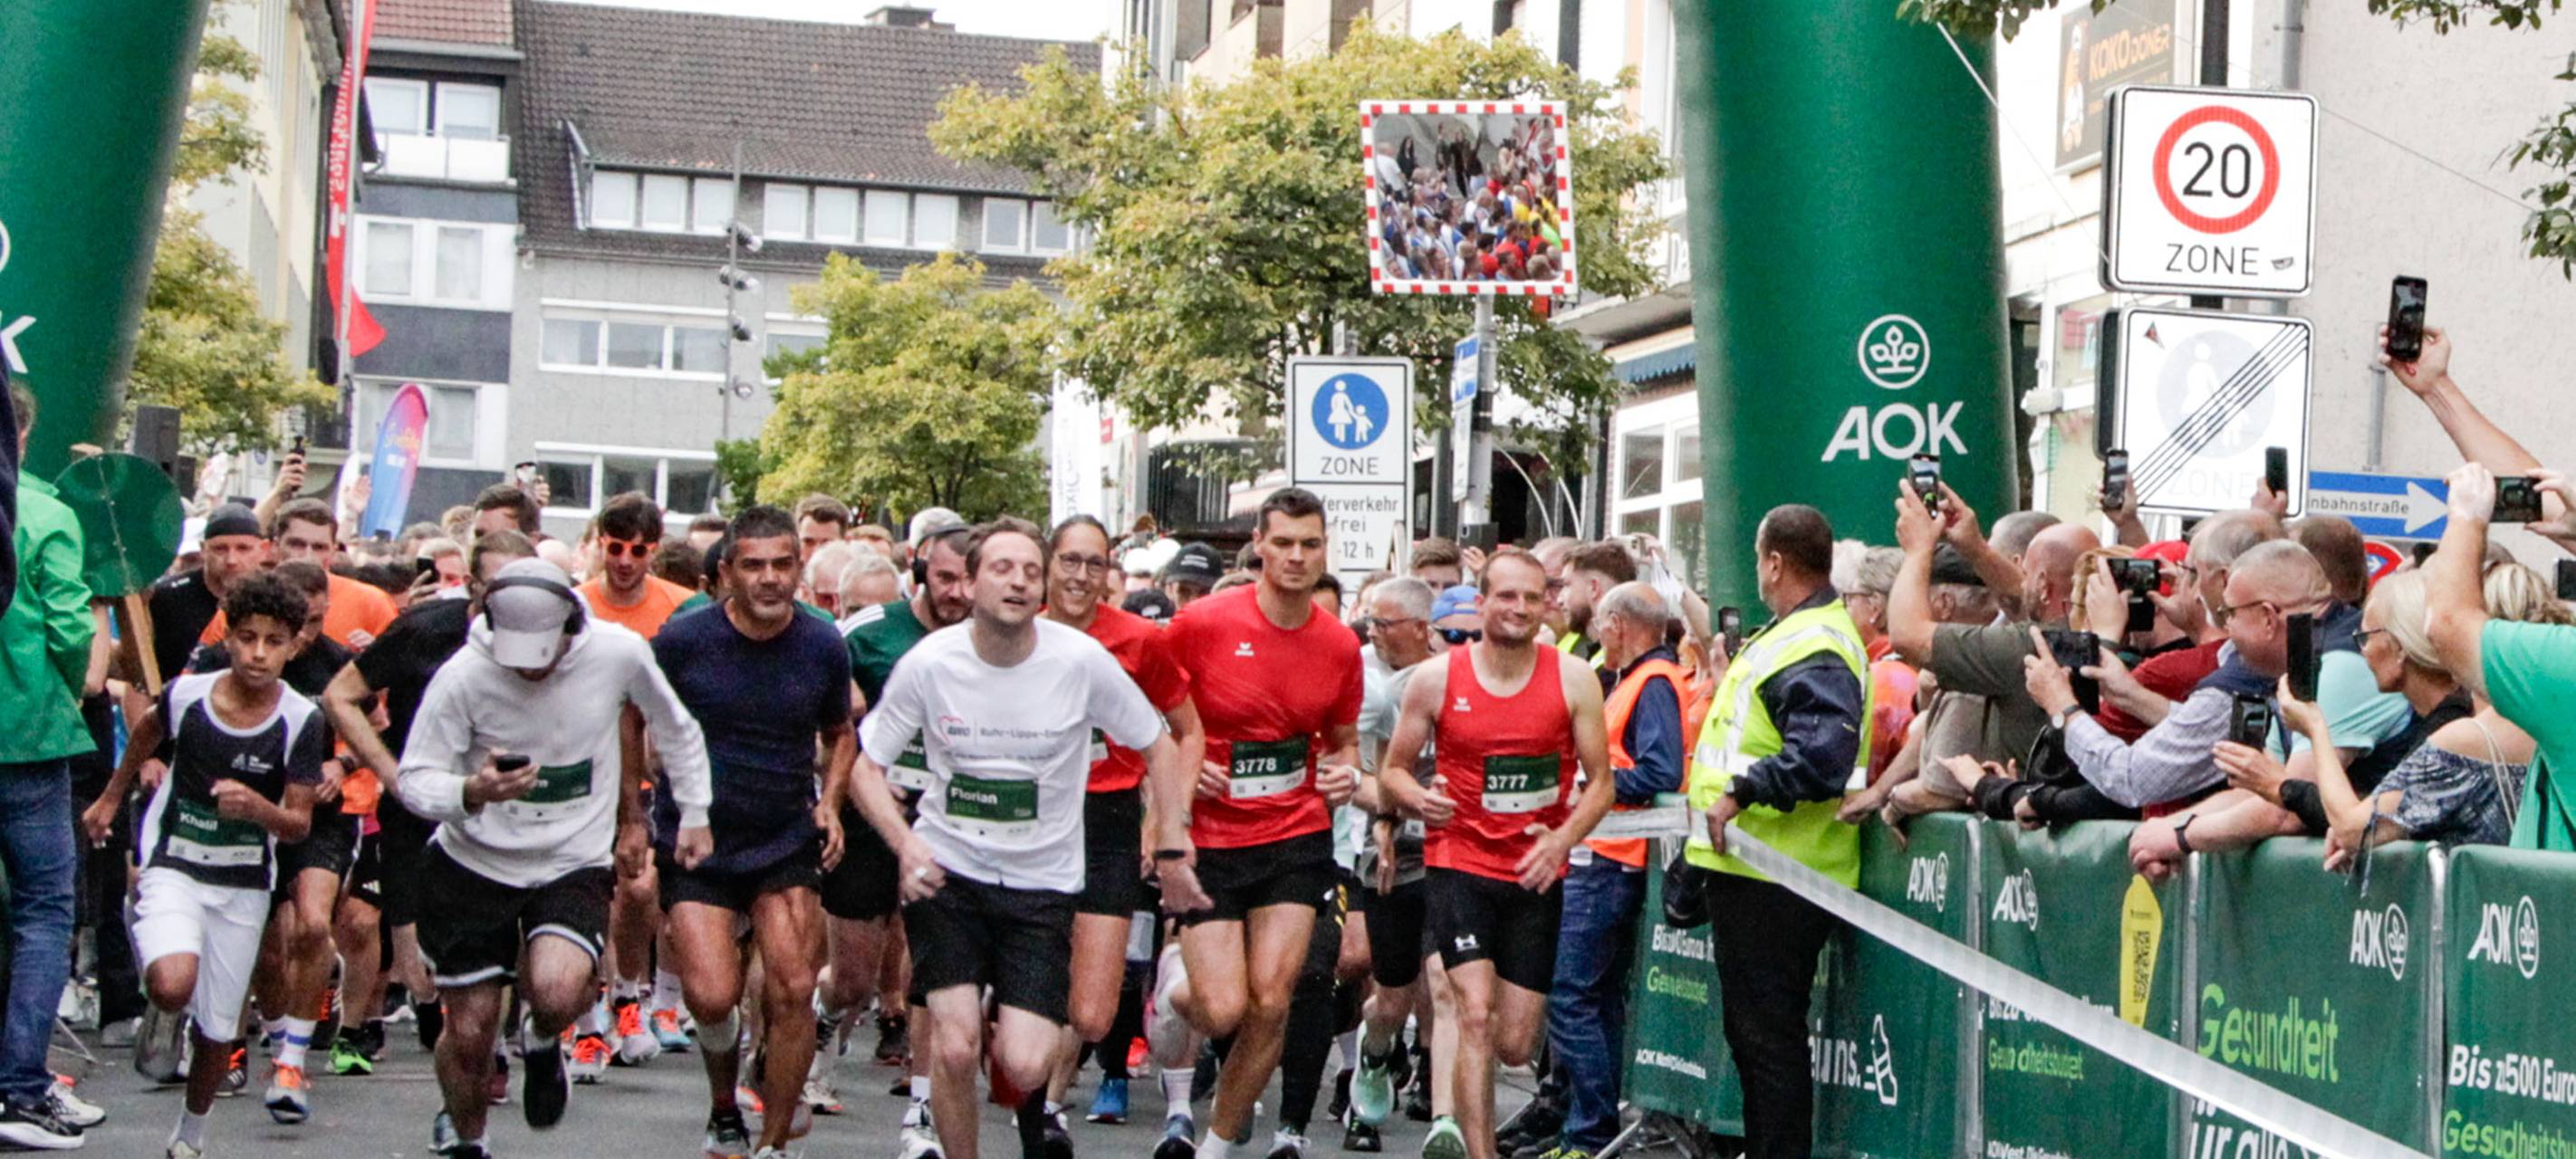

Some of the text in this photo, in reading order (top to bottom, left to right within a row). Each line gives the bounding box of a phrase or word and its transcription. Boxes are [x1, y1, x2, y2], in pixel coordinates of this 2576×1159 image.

[2090, 28, 2130, 81] KOKO
[2183, 141, 2252, 199] 20
[2166, 243, 2260, 275] ZONE
[1821, 401, 1968, 462] AOK
[1321, 456, 1379, 475] ZONE
[2306, 495, 2409, 514] inbahnstraße
[1365, 542, 1374, 559] h
[1235, 757, 1276, 774] 3778
[1487, 774, 1529, 790] 3777
[951, 787, 998, 805] Florian
[179, 811, 218, 831] Khalil
[1907, 857, 1936, 903] AOK
[2350, 908, 2386, 968] AOK
[2467, 903, 2513, 965] AOK
[2197, 983, 2339, 1083] Gesundheit
[2448, 1044, 2492, 1089] Bis
[2505, 1053, 2540, 1098] 500
[2542, 1058, 2576, 1105] Euro
